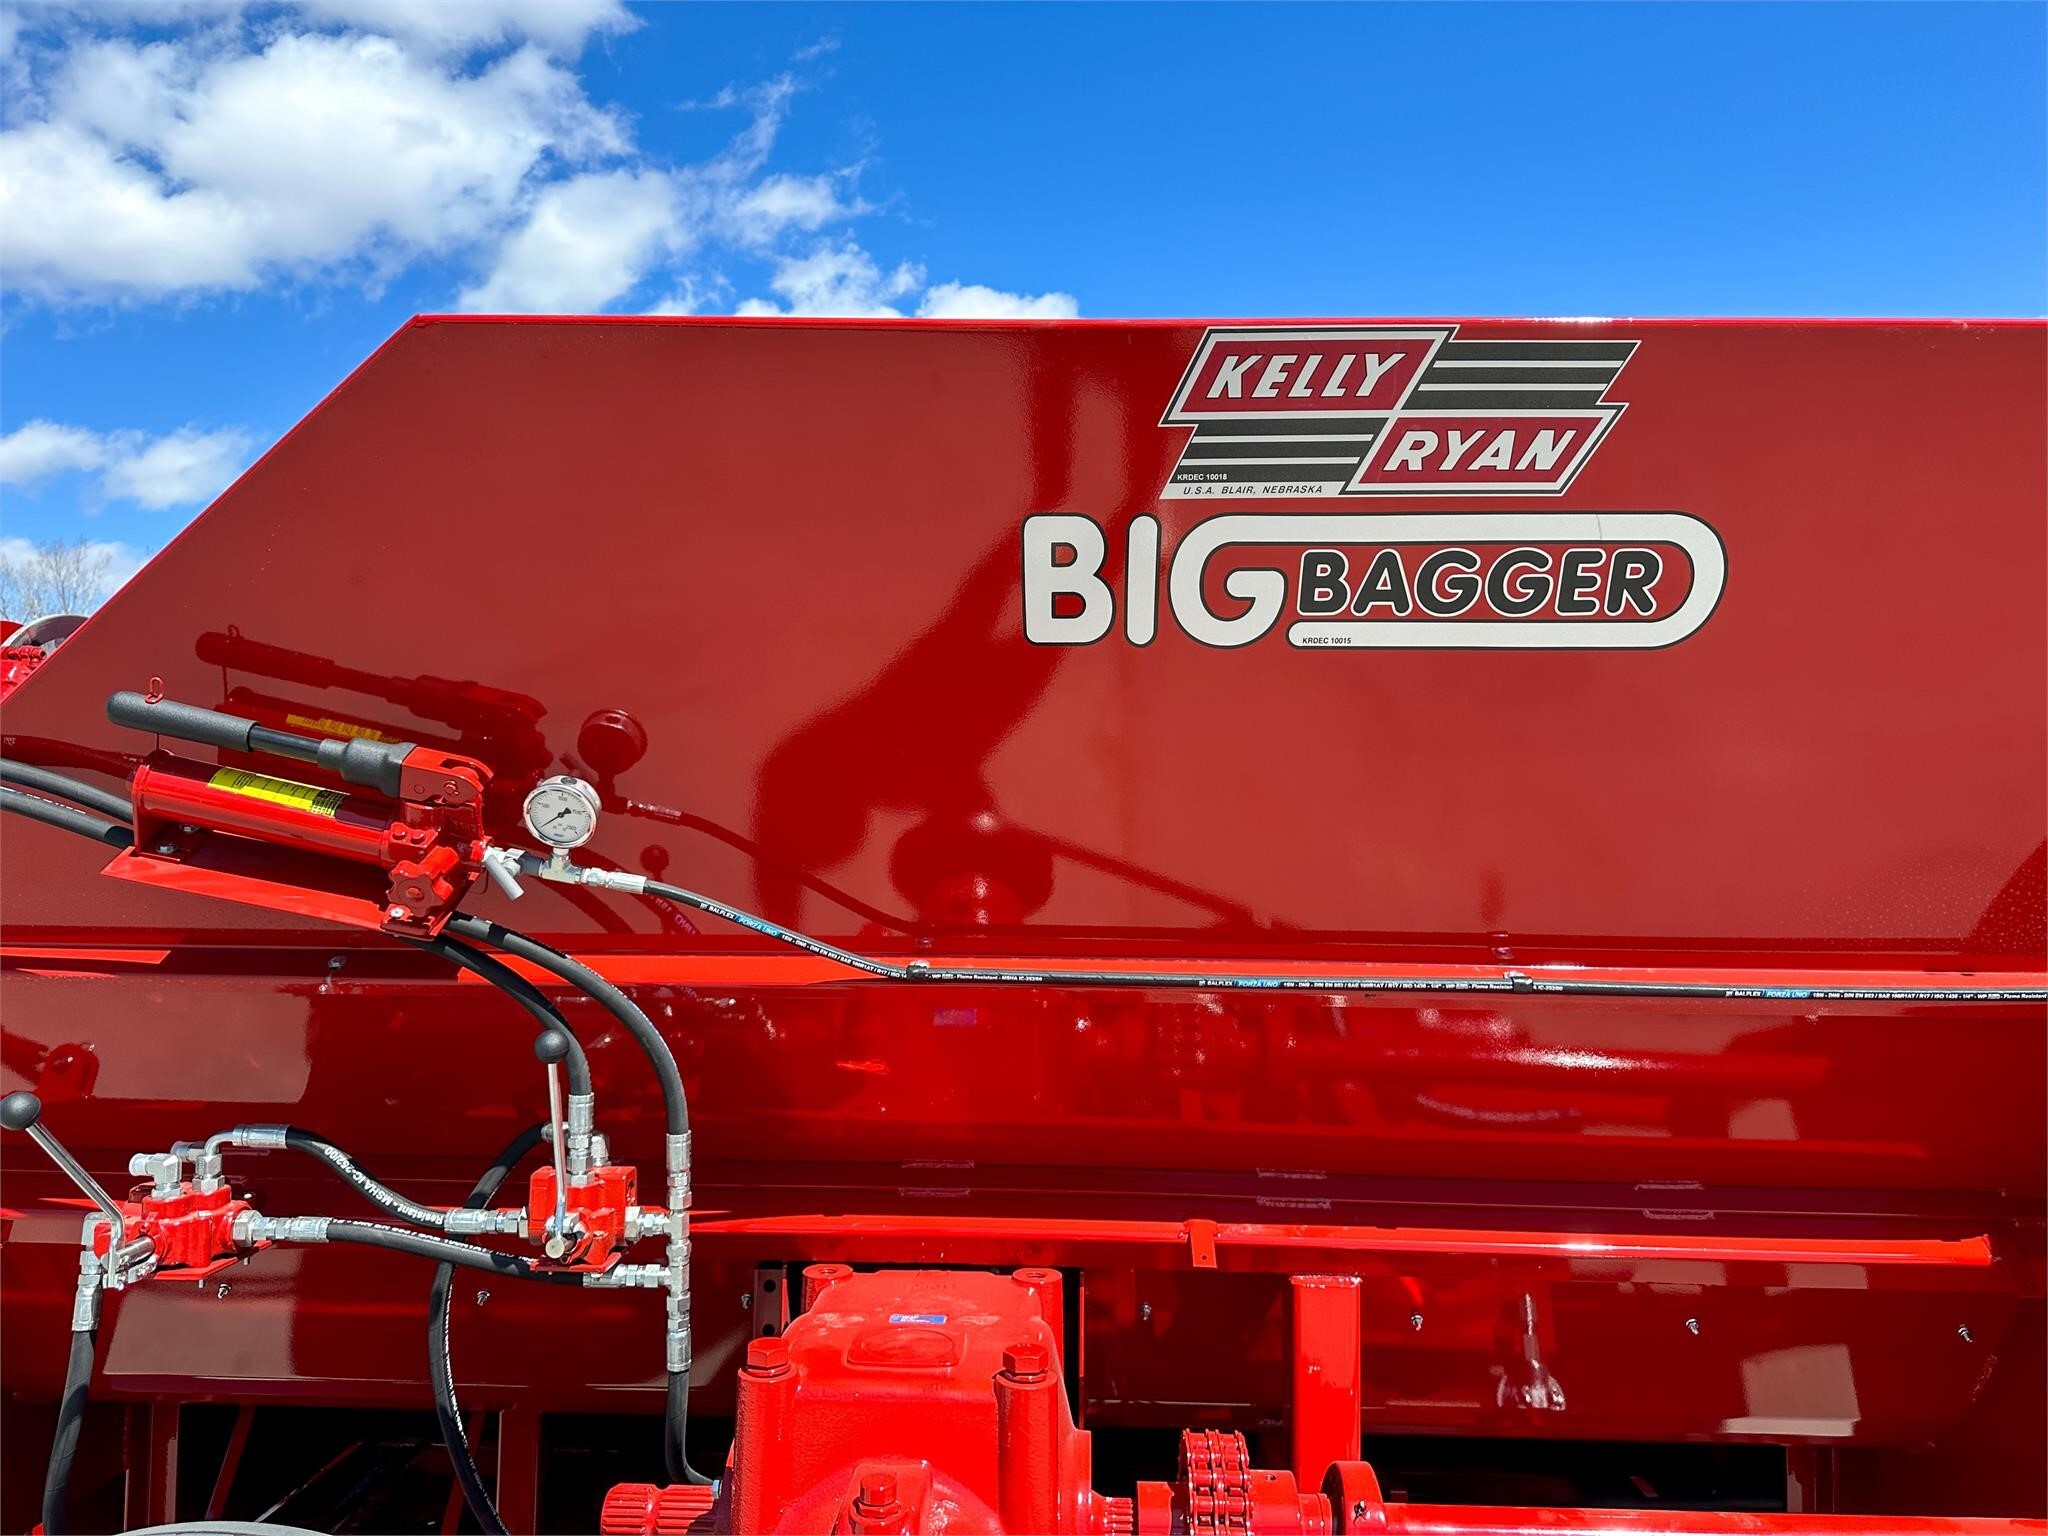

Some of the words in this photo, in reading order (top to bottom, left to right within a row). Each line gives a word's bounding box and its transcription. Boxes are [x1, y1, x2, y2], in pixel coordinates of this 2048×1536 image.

[1206, 353, 1406, 398] KELLY
[1382, 429, 1577, 471] RYAN
[1177, 473, 1204, 481] KRDEC
[1206, 473, 1228, 481] 10018
[1183, 486, 1215, 495] U.S.A.
[1221, 486, 1256, 496] BLAIR,
[1262, 485, 1323, 494] NEBRASKA
[1022, 513, 1287, 647] BIG
[1299, 547, 1663, 617] BAGGER
[708, 905, 735, 920] BALFLEX
[738, 917, 761, 931] FORZA
[762, 925, 778, 937] UNO
[1238, 979, 1262, 988] FORZA
[1263, 980, 1279, 988] UNO
[1766, 990, 1790, 998] FORZA
[324, 1146, 365, 1184] IC-252/00
[363, 1181, 393, 1207] MSHA
[396, 1203, 444, 1225] Resistant
